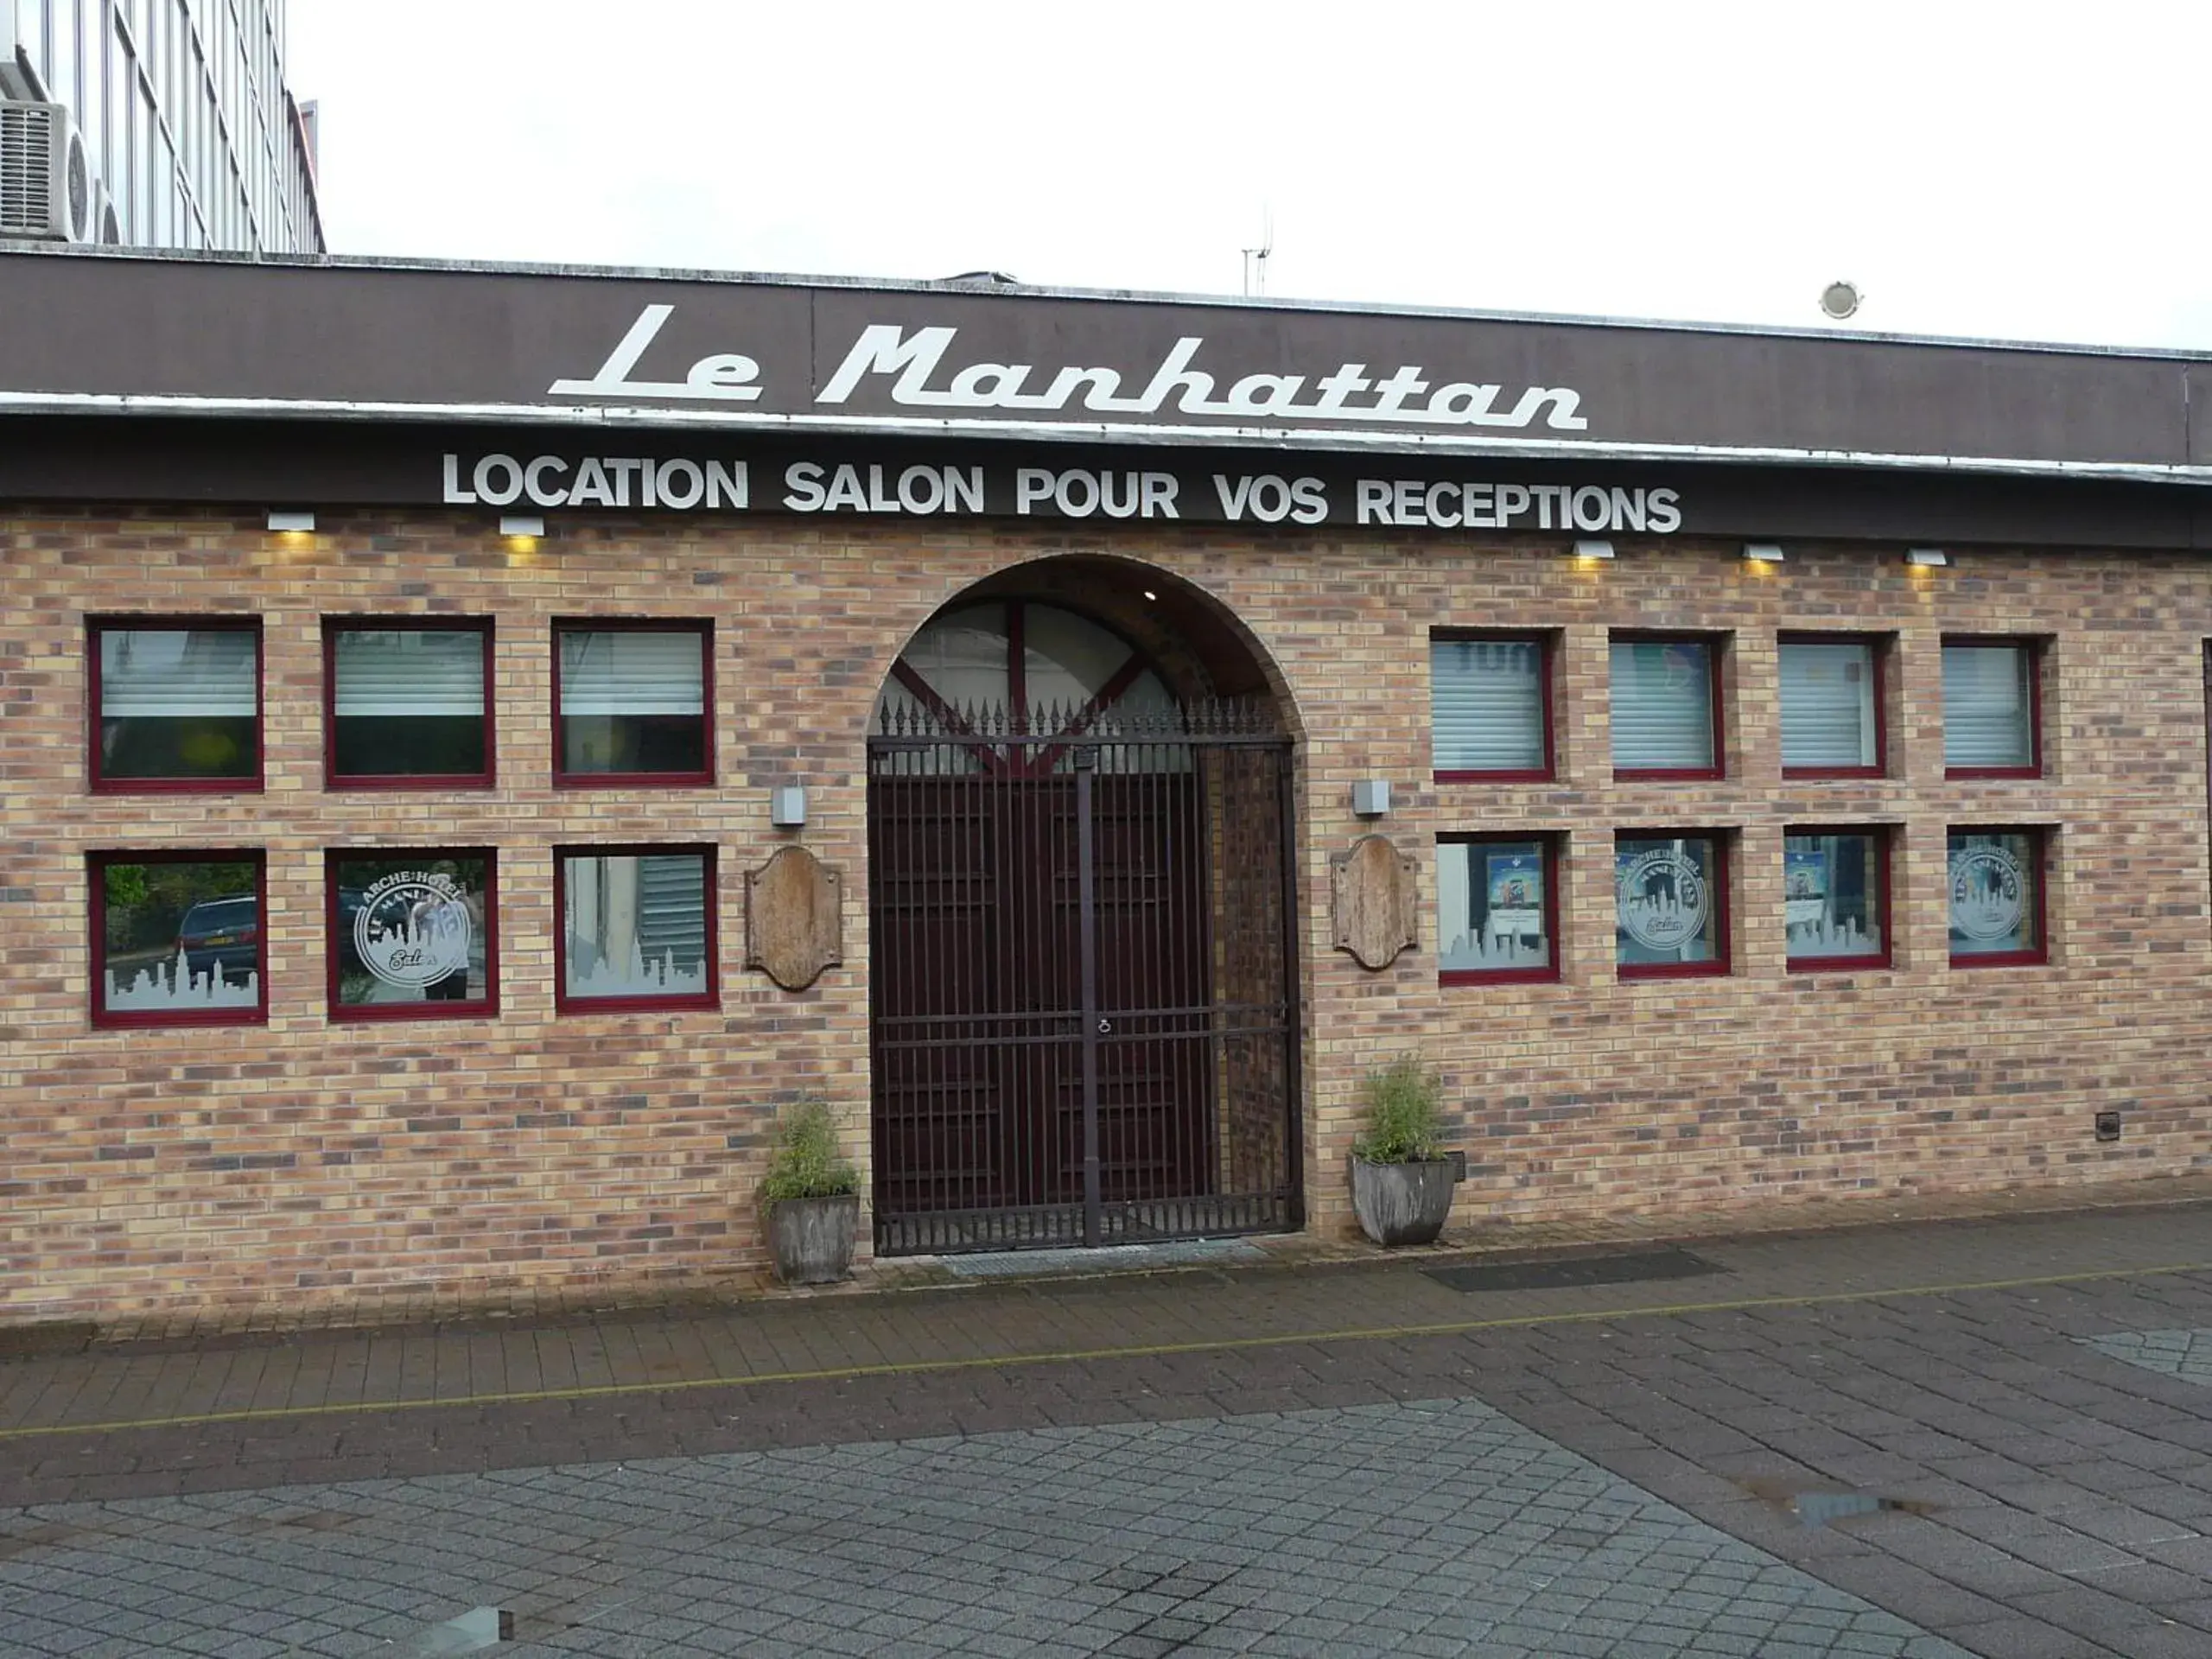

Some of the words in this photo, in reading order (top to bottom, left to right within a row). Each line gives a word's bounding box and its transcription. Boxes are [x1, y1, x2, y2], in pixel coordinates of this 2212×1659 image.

[547, 304, 764, 401] Le
[814, 324, 1587, 430] Manhattan
[443, 454, 748, 510] LOCATION
[783, 461, 984, 515] SALON
[1017, 468, 1179, 520] POUR
[1212, 474, 1328, 524] VOS
[1357, 478, 1681, 533] RECEPTIONS
